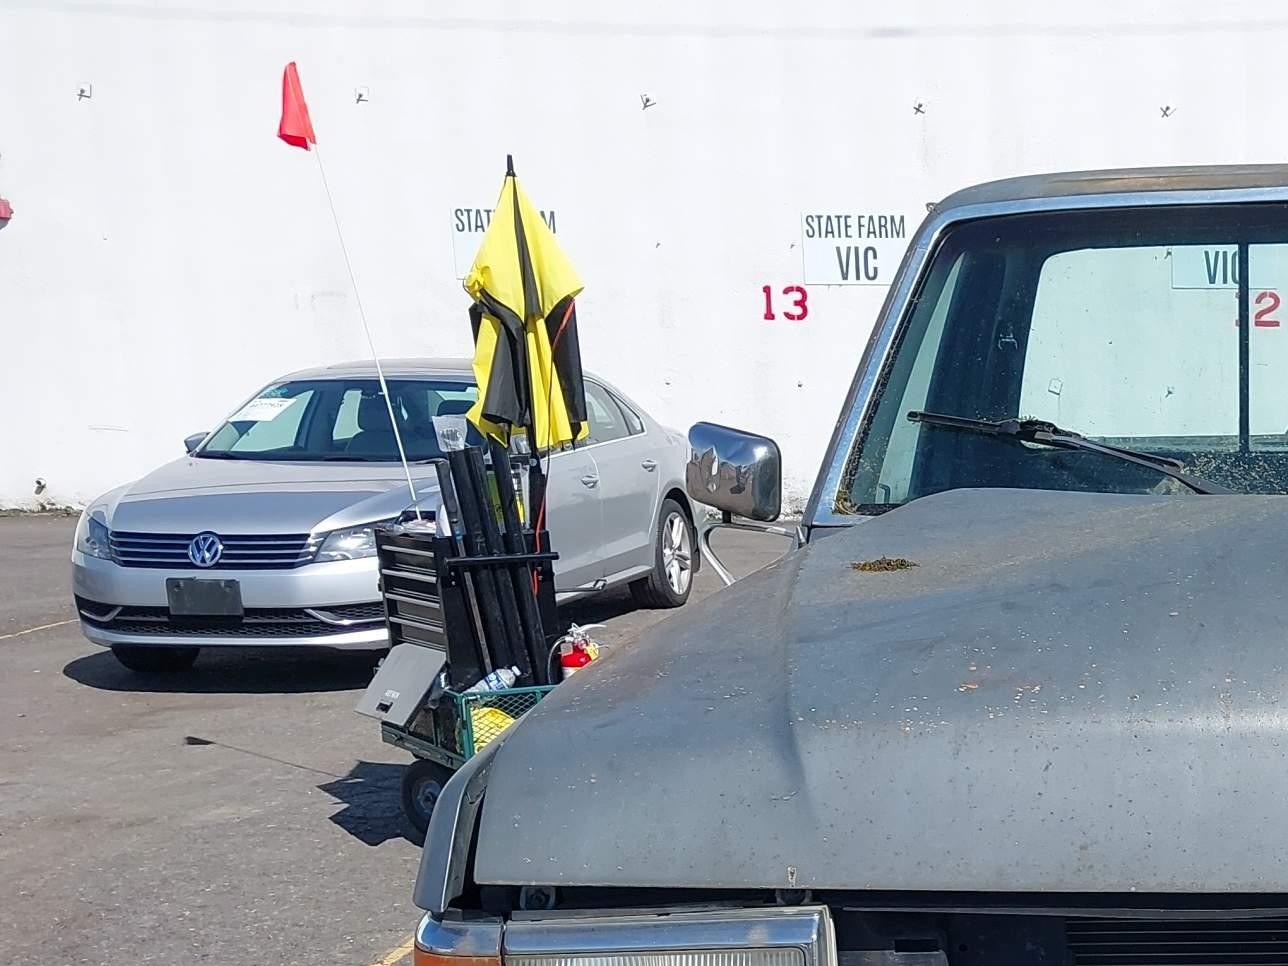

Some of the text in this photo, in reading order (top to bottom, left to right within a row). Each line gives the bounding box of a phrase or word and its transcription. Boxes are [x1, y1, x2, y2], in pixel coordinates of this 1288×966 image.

[454, 208, 496, 233] STAT
[805, 214, 906, 239] STATE FARM
[835, 246, 879, 281] VIC
[762, 285, 808, 321] 13
